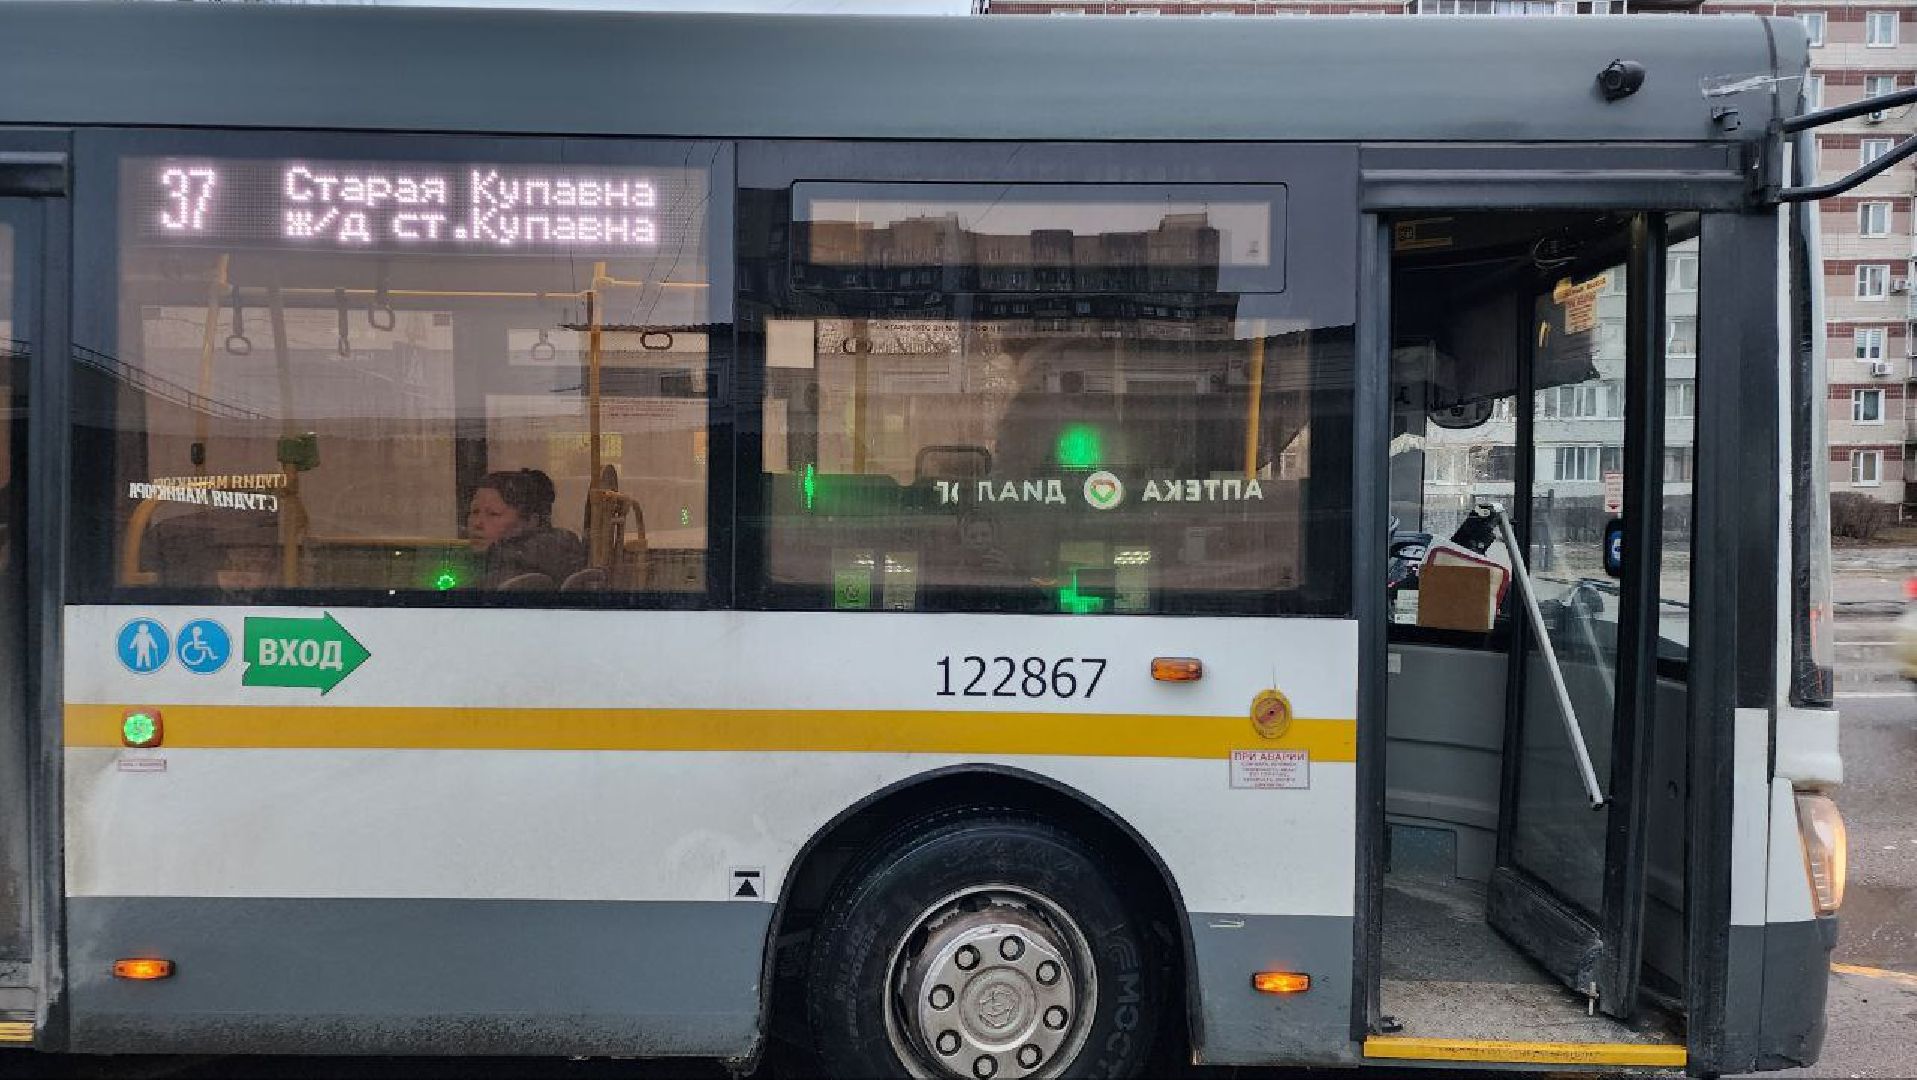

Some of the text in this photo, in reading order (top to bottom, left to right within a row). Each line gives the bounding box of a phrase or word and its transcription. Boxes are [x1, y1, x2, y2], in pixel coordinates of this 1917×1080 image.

[159, 166, 215, 230] 37
[285, 166, 656, 209] Старая Купавна
[259, 638, 343, 671] ВХОД
[936, 656, 1107, 698] 122867
